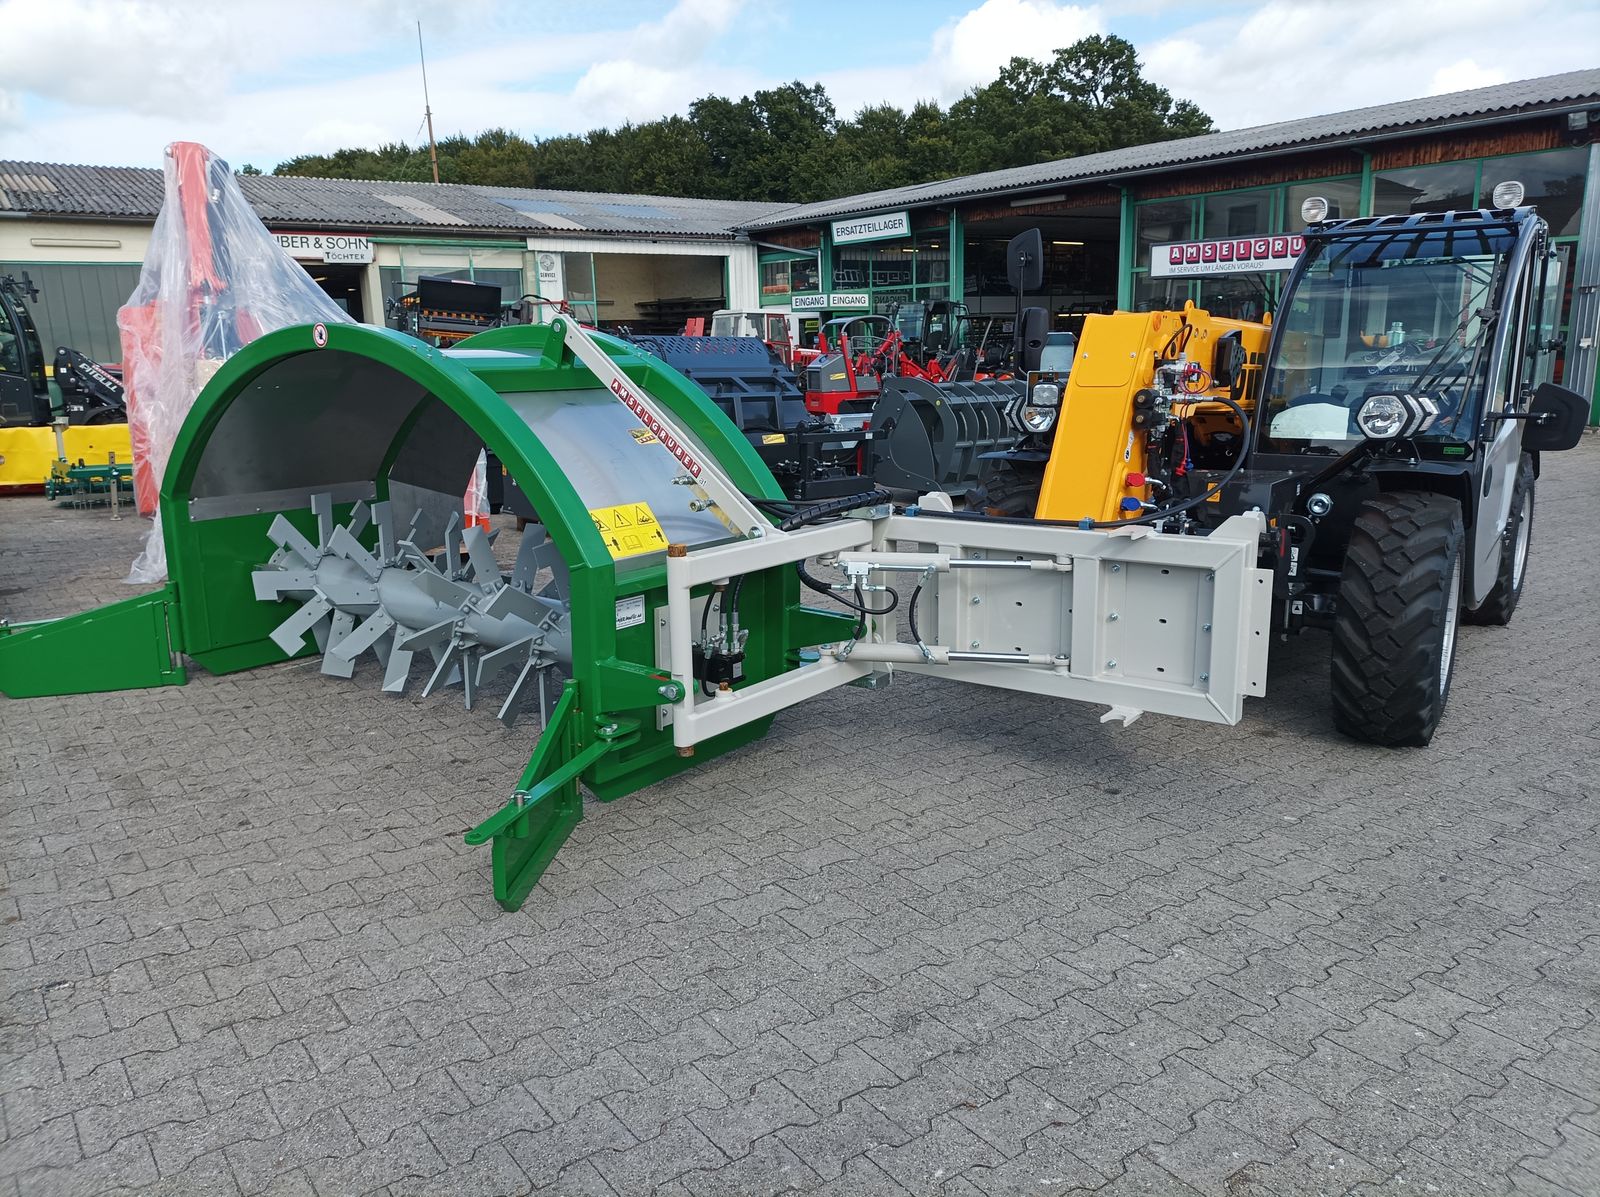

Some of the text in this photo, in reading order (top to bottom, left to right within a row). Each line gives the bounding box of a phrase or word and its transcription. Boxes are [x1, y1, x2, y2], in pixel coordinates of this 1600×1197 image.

[836, 218, 904, 236] ERSATZTEILLAGER
[277, 236, 369, 249] BER & SOHN
[1212, 263, 1237, 271] LÄNGEN
[1237, 262, 1264, 270] VORAUS!
[795, 296, 825, 306] EINGANG
[832, 296, 866, 305] EINGANG
[79, 363, 118, 392] PITBULL
[612, 379, 700, 476] AMSELGRUBER
